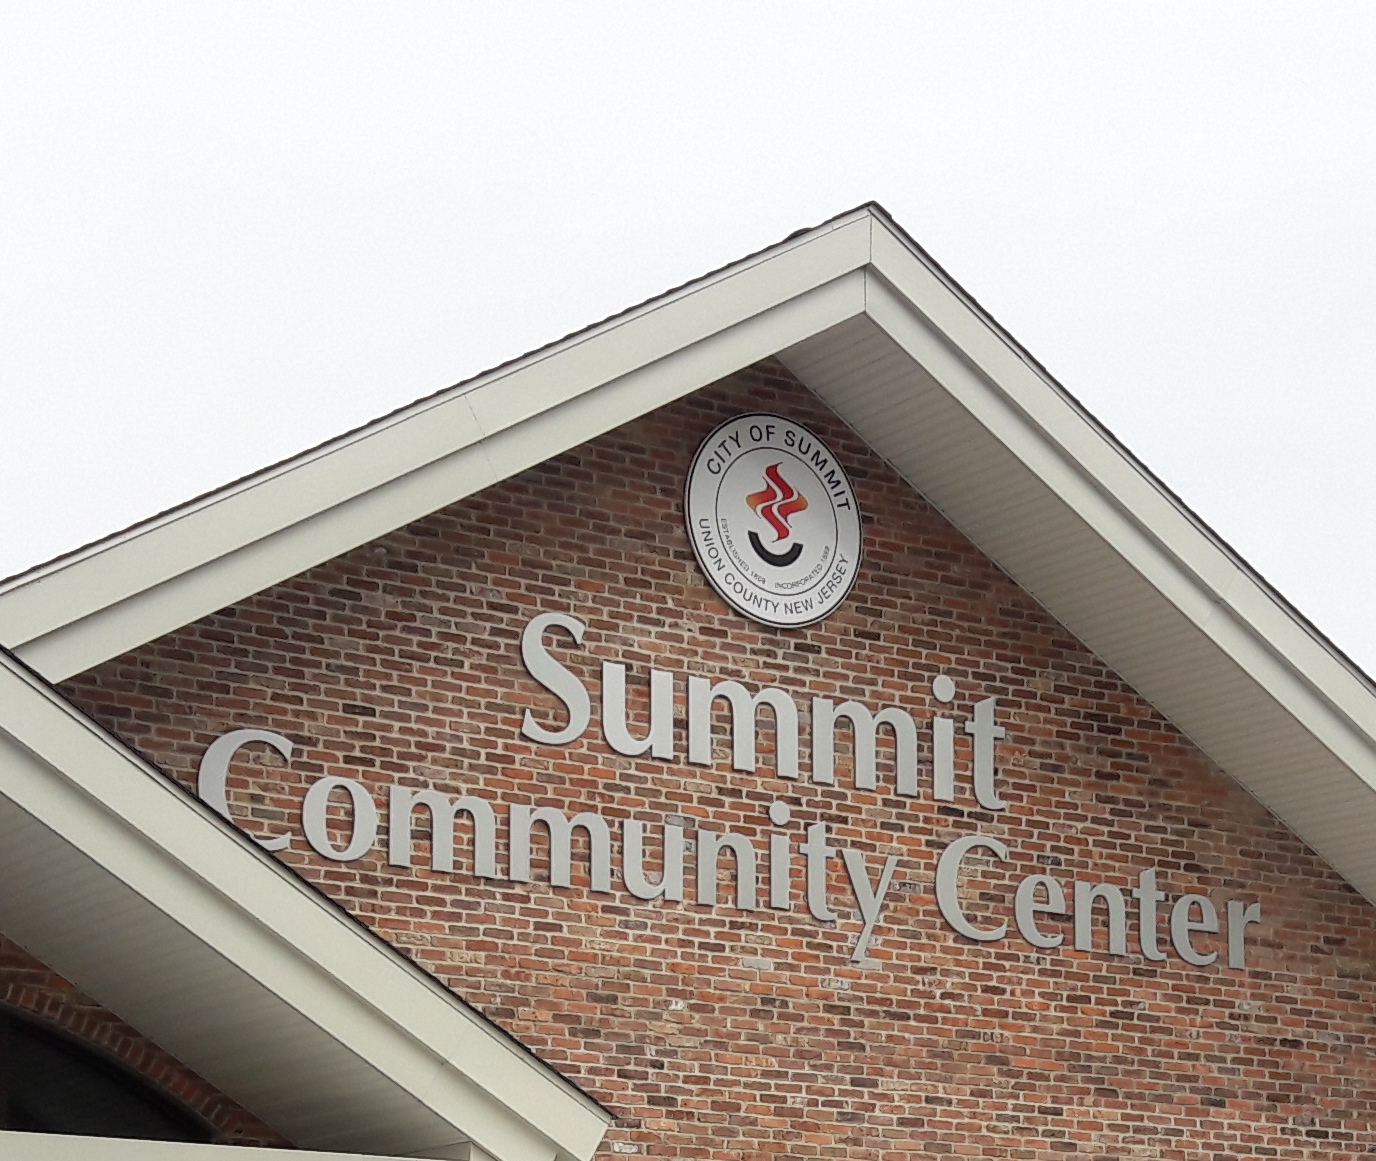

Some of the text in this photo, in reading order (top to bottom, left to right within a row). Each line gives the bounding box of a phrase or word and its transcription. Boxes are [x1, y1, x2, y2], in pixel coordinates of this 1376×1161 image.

[706, 424, 851, 512] CITY OF SUMMIT
[698, 518, 850, 616] UNION COUNTY NEW JERSEY
[520, 611, 1006, 811] Summit
[198, 728, 1261, 970] Community Center
